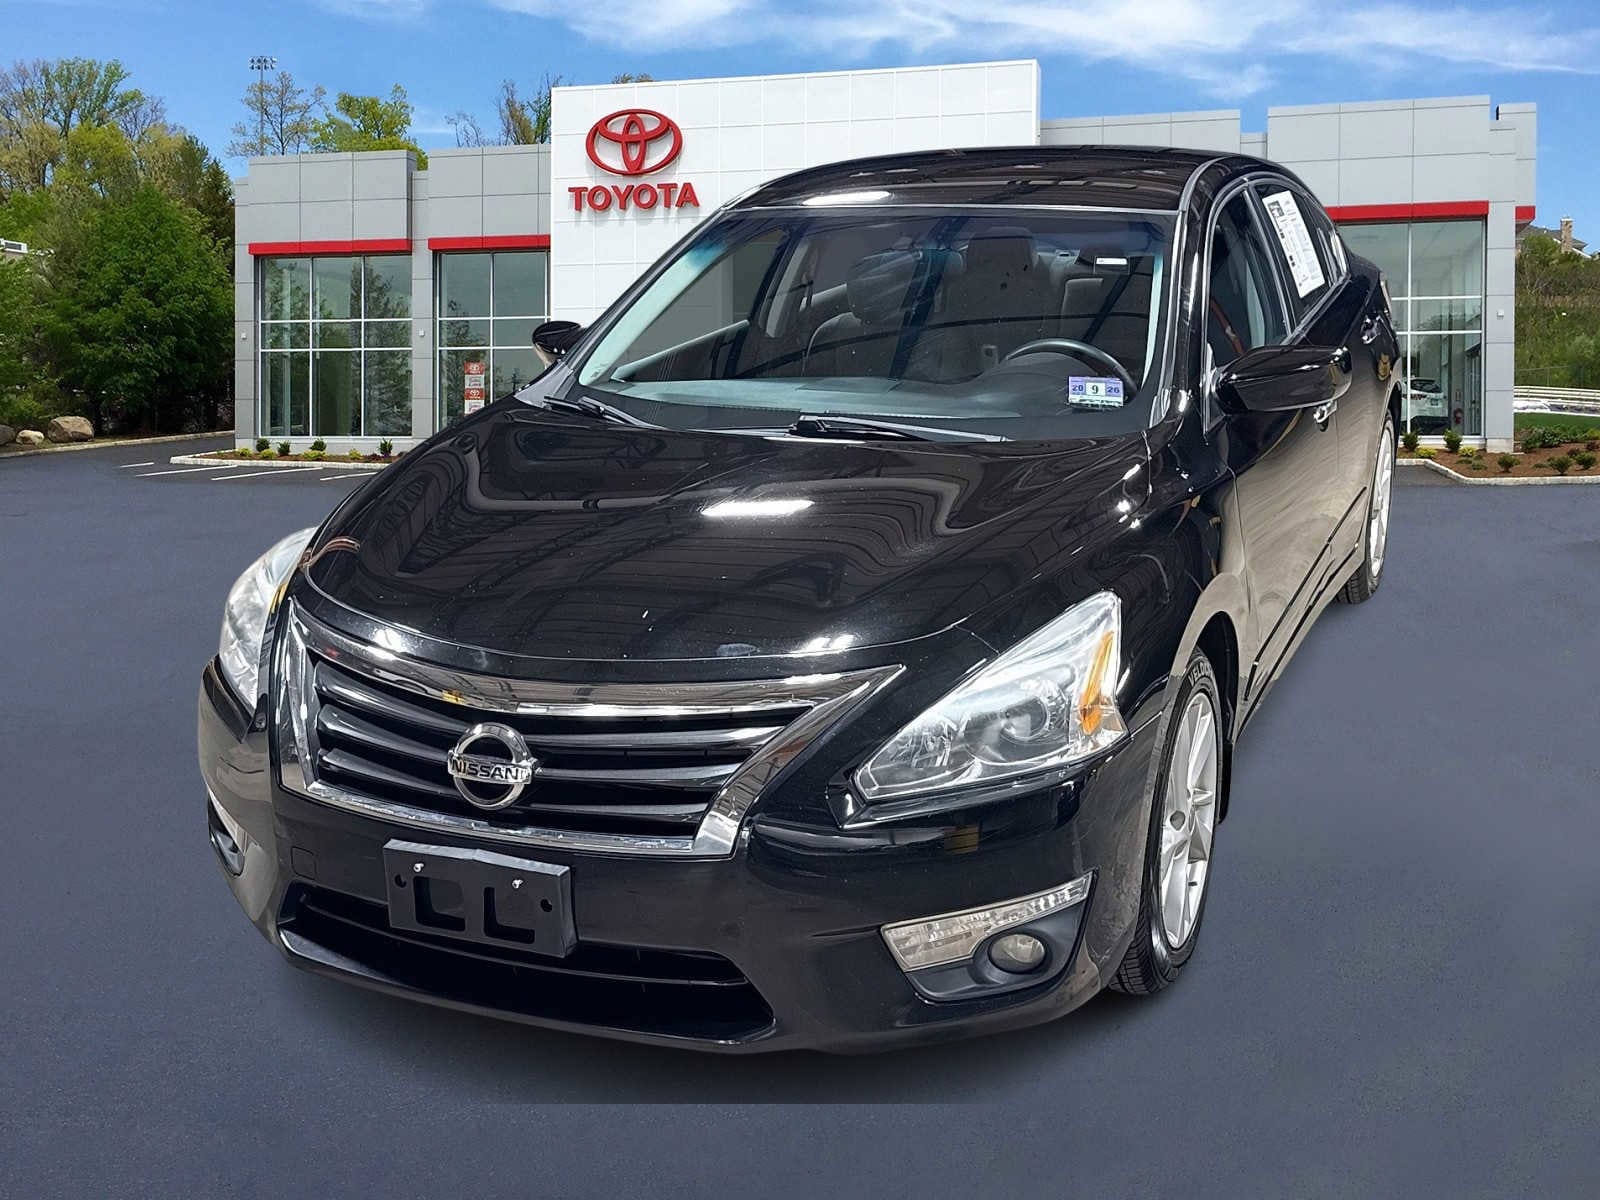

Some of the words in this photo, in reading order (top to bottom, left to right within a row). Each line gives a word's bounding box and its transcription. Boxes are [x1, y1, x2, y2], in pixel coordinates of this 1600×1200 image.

[568, 182, 700, 211] TOYOTA
[1072, 384, 1084, 392] 20
[1091, 384, 1099, 394] 9
[452, 758, 519, 780] NISSAN
